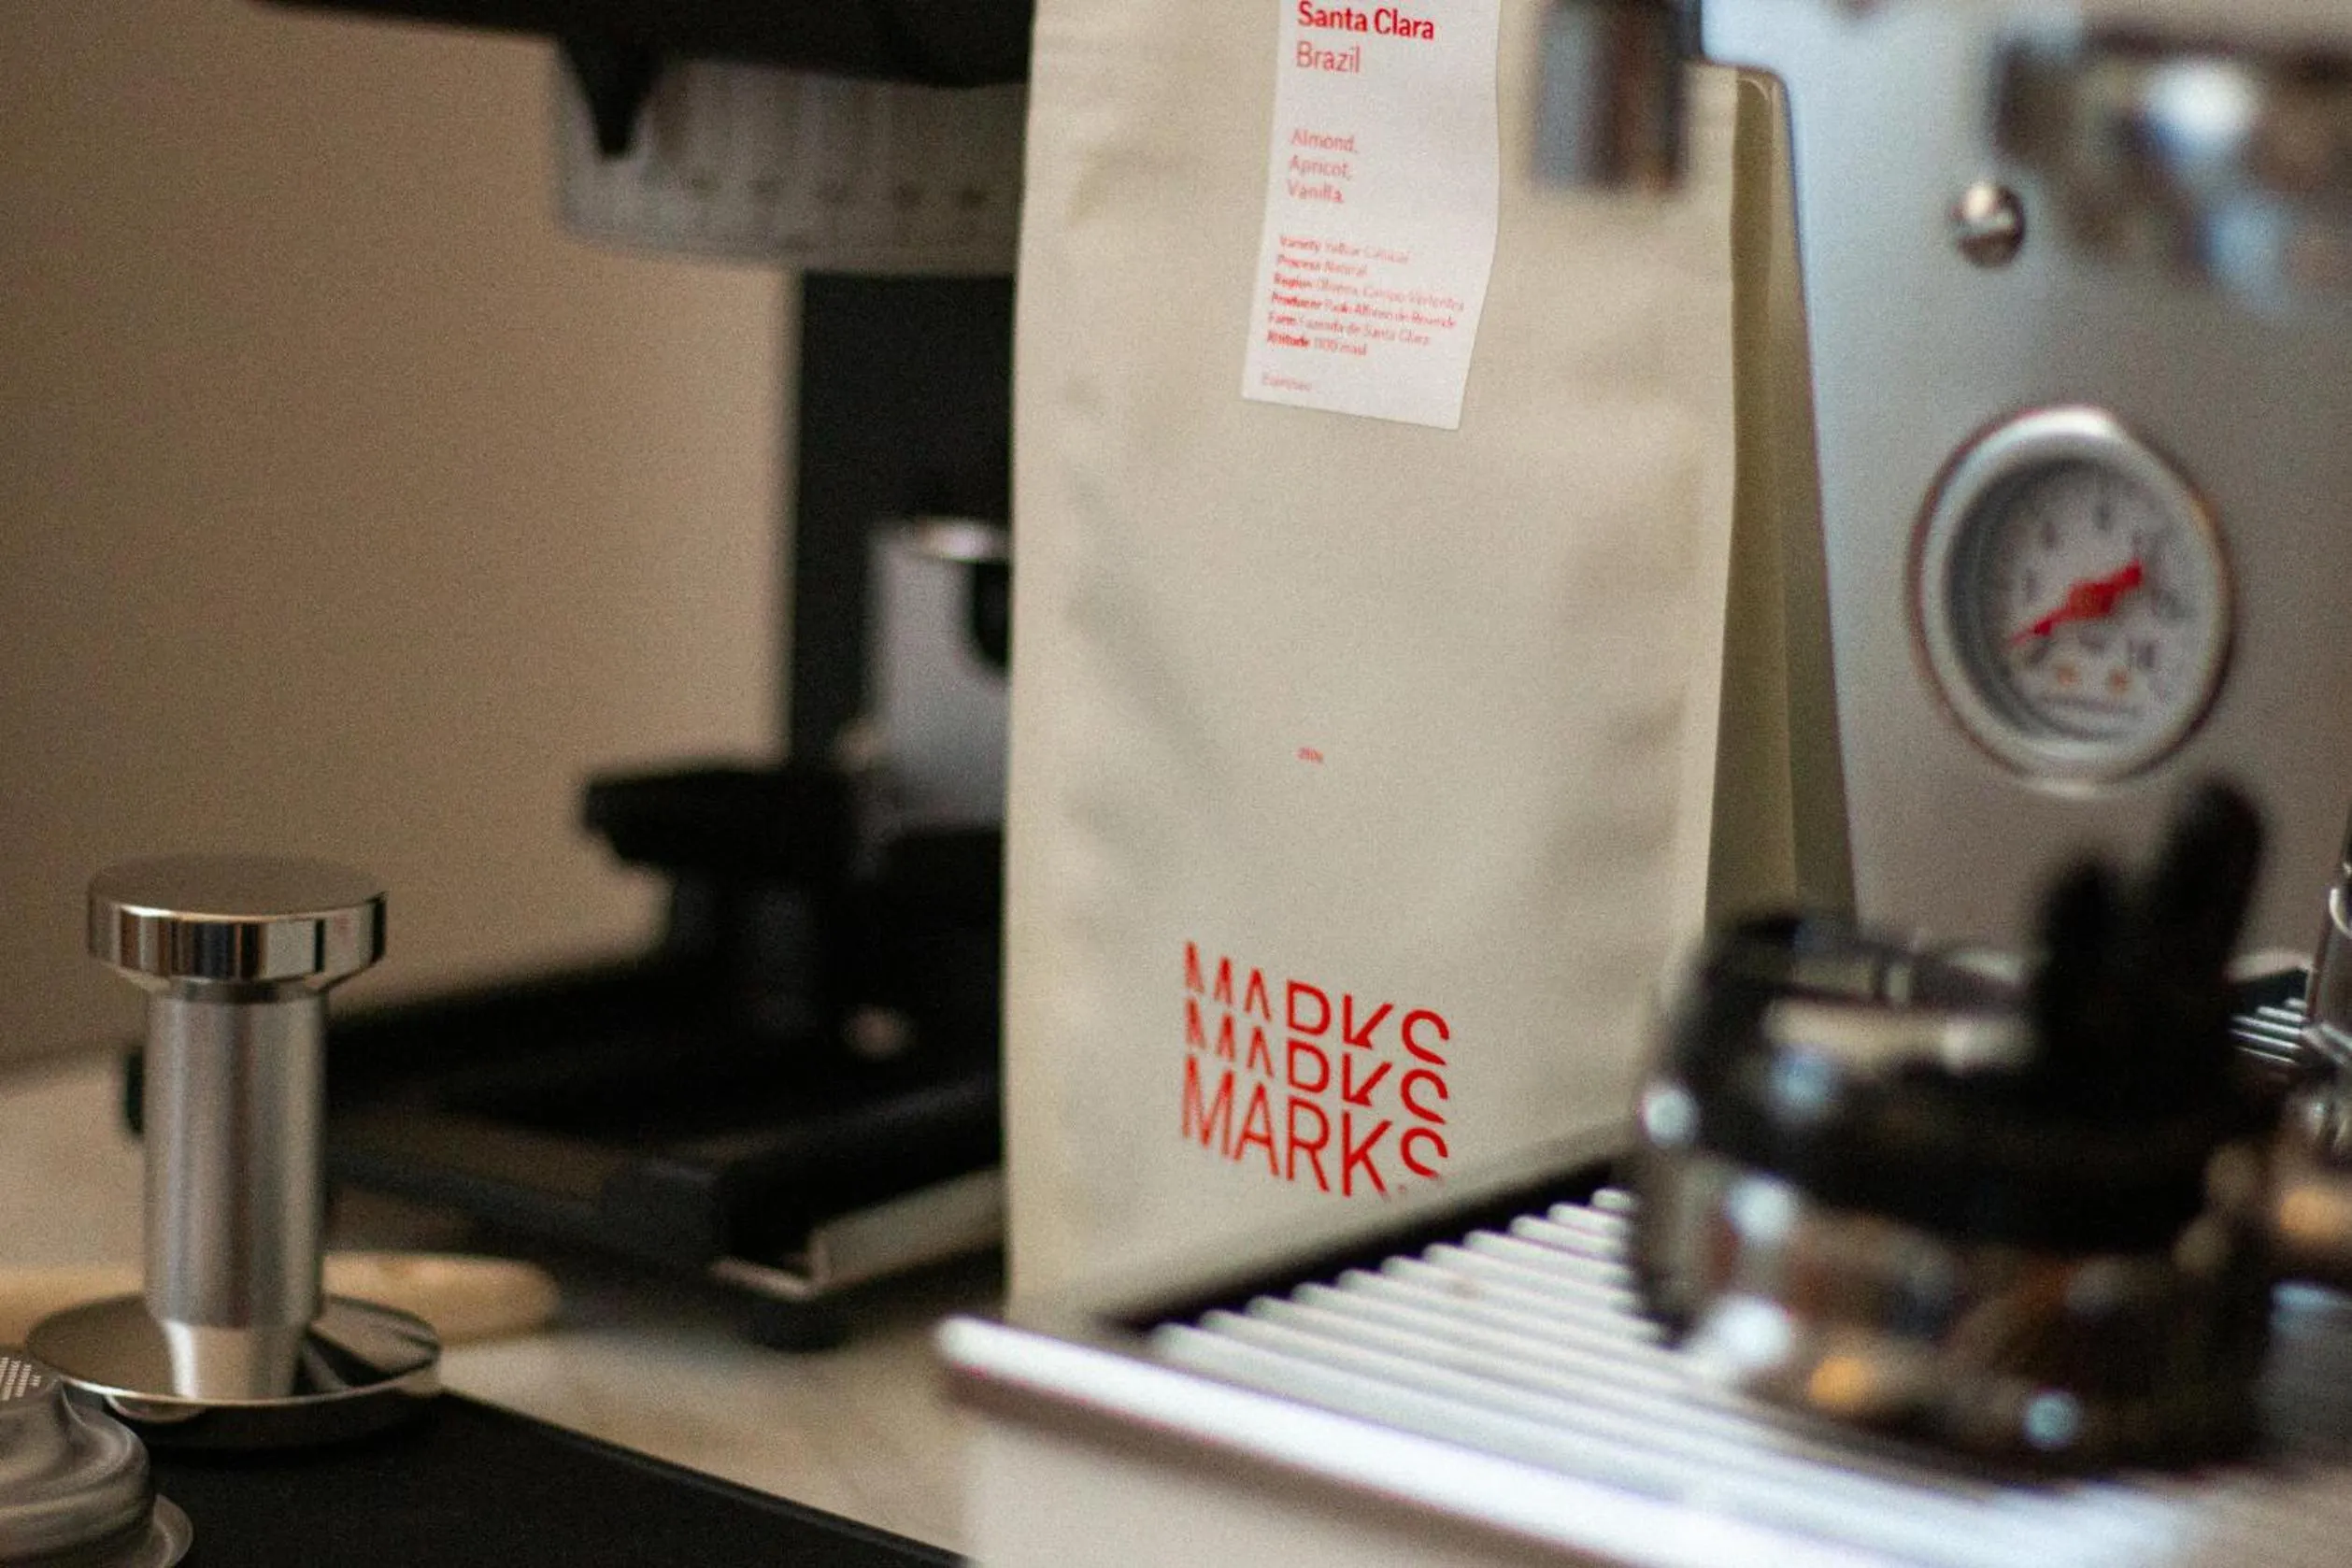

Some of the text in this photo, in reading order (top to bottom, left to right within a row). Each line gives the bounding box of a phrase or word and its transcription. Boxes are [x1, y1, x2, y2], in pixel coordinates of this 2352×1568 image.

[1297, 0, 1434, 39] Santa Clara
[1295, 40, 1361, 74] Brazil
[1182, 1053, 1449, 1202] MARKS
